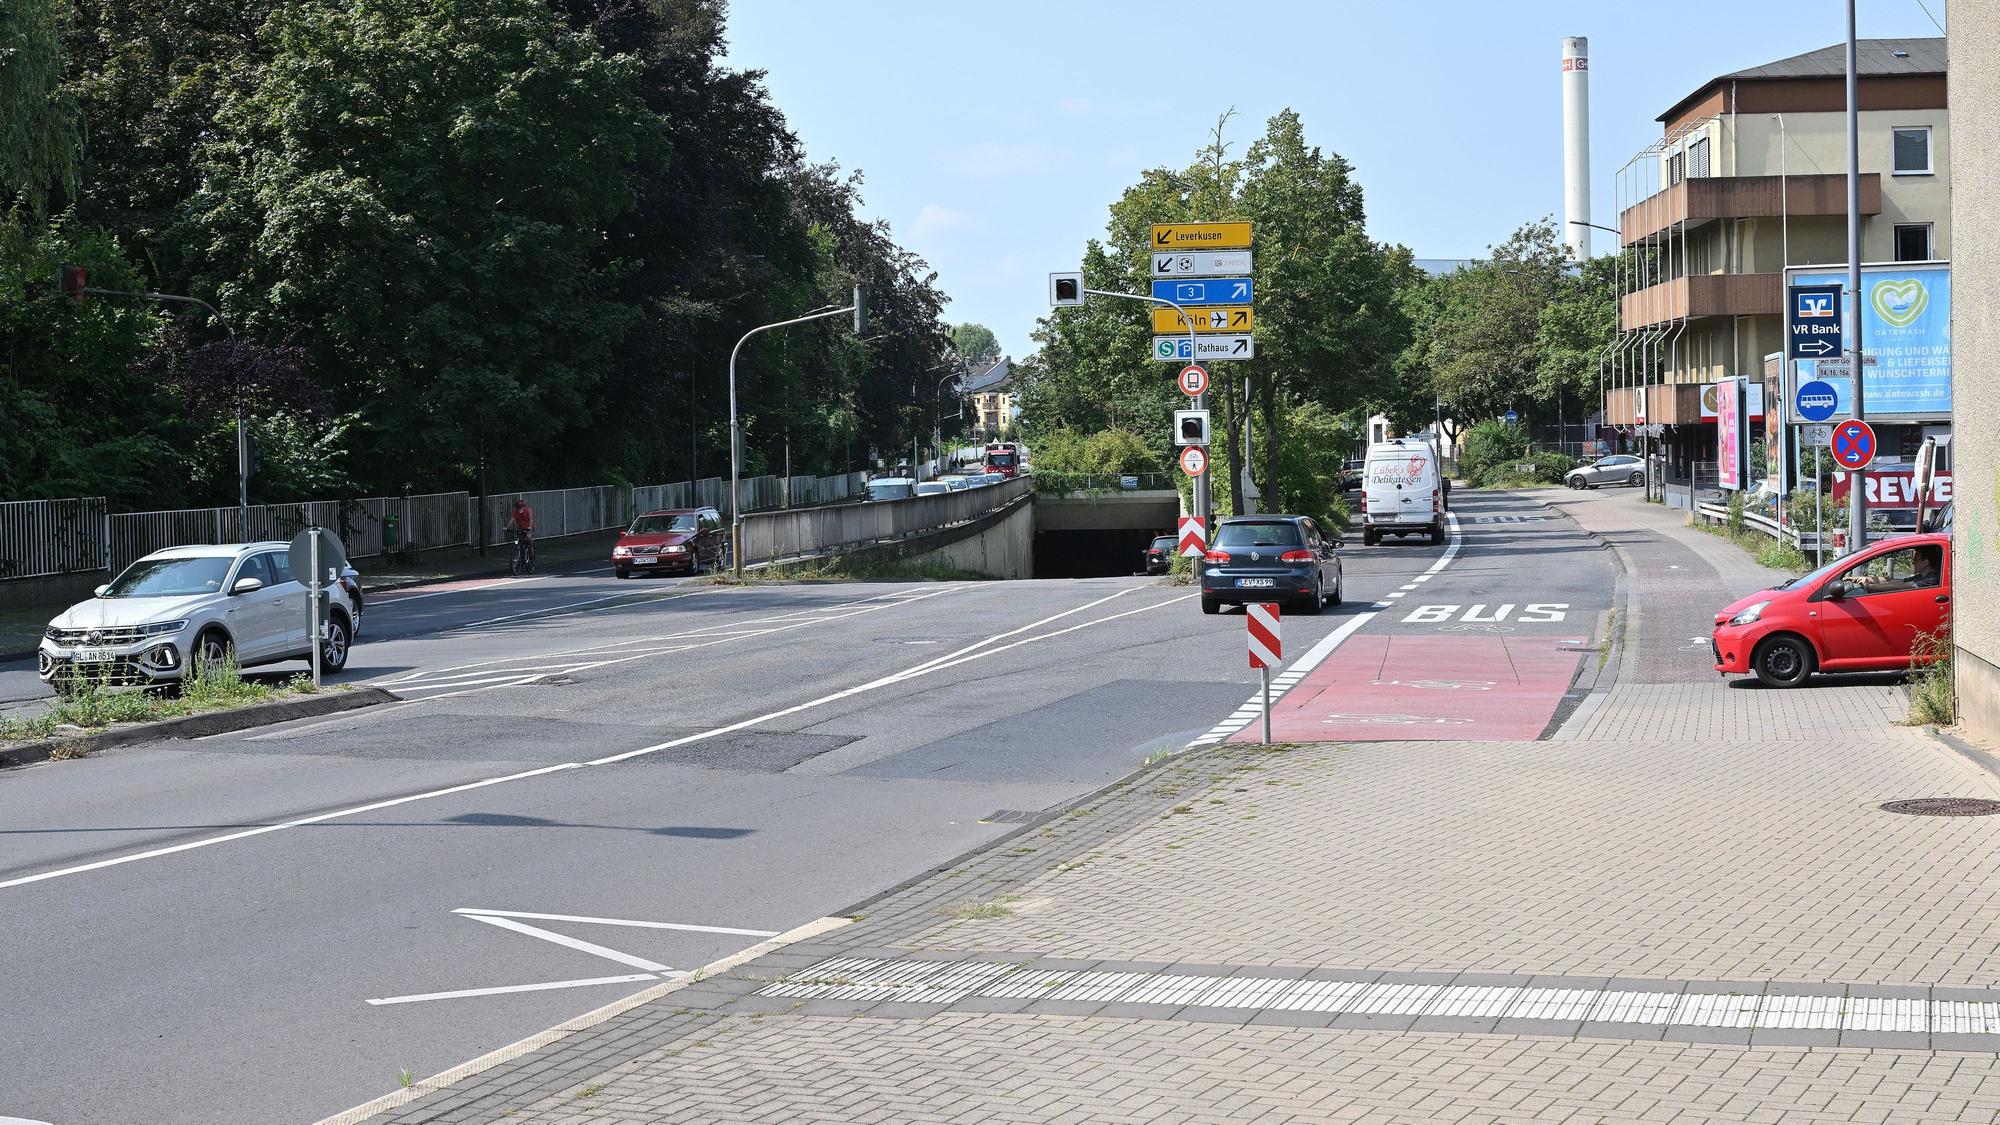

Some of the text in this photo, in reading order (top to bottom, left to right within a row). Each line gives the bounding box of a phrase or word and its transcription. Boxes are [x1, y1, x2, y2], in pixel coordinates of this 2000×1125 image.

[1175, 231, 1222, 241] Leverkusen
[1188, 287, 1195, 298] 3
[1177, 314, 1207, 326] Köln
[1792, 324, 1840, 335] VR Bank
[1874, 328, 1925, 336] DATEWASH
[1197, 342, 1229, 353] Rathaus
[1905, 346, 1929, 356] UND
[1887, 359, 1895, 368] &
[1864, 476, 1952, 503] REWE
[1240, 578, 1253, 586] LEV
[1400, 604, 1570, 622] BUS
[88, 652, 97, 661] AN
